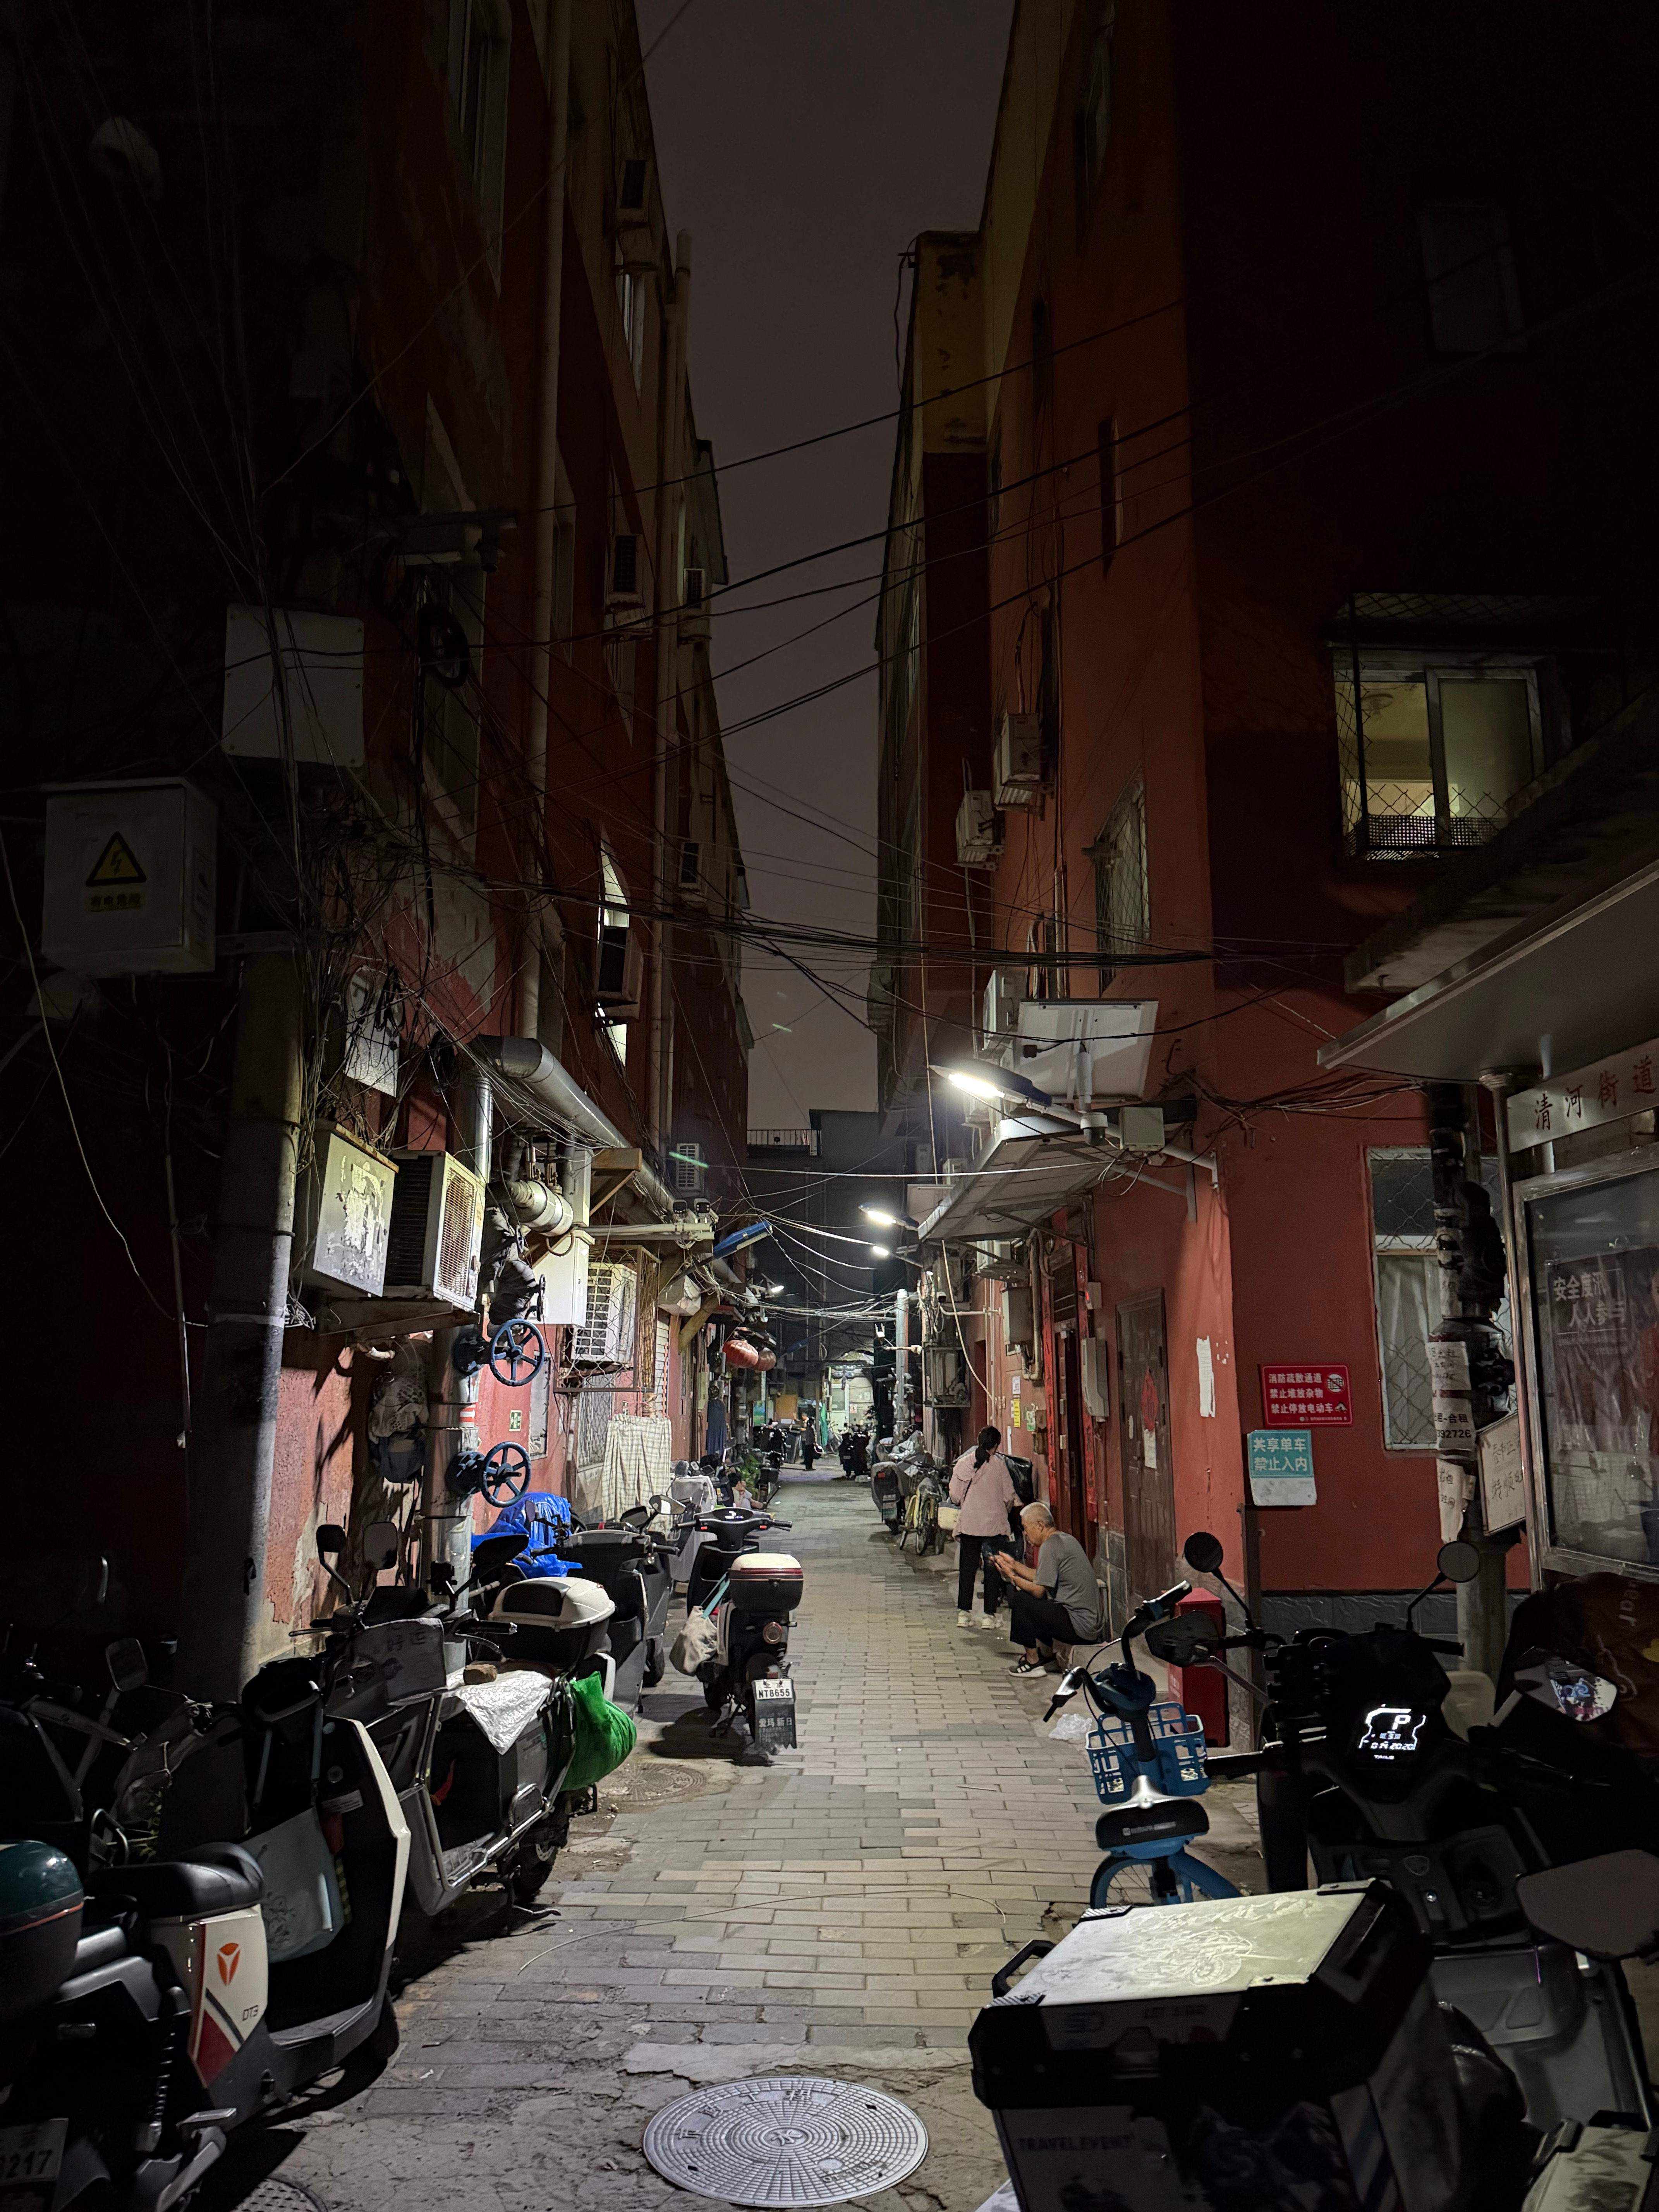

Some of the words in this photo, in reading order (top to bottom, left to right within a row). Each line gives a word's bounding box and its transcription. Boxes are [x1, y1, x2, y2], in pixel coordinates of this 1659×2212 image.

[1535, 1055, 1657, 1130] 清河街道
[1268, 1372, 1323, 1384] 消防疏散通道
[1269, 1388, 1324, 1399] 禁止堆放杂物
[1271, 1402, 1334, 1414] 禁止停放电动车
[1253, 1437, 1307, 1452] 共享单车
[1254, 1456, 1308, 1472] 禁止入内
[759, 1689, 790, 1698] NT8655
[1392, 1715, 1411, 1730] P
[242, 2005, 258, 2021] DT3
